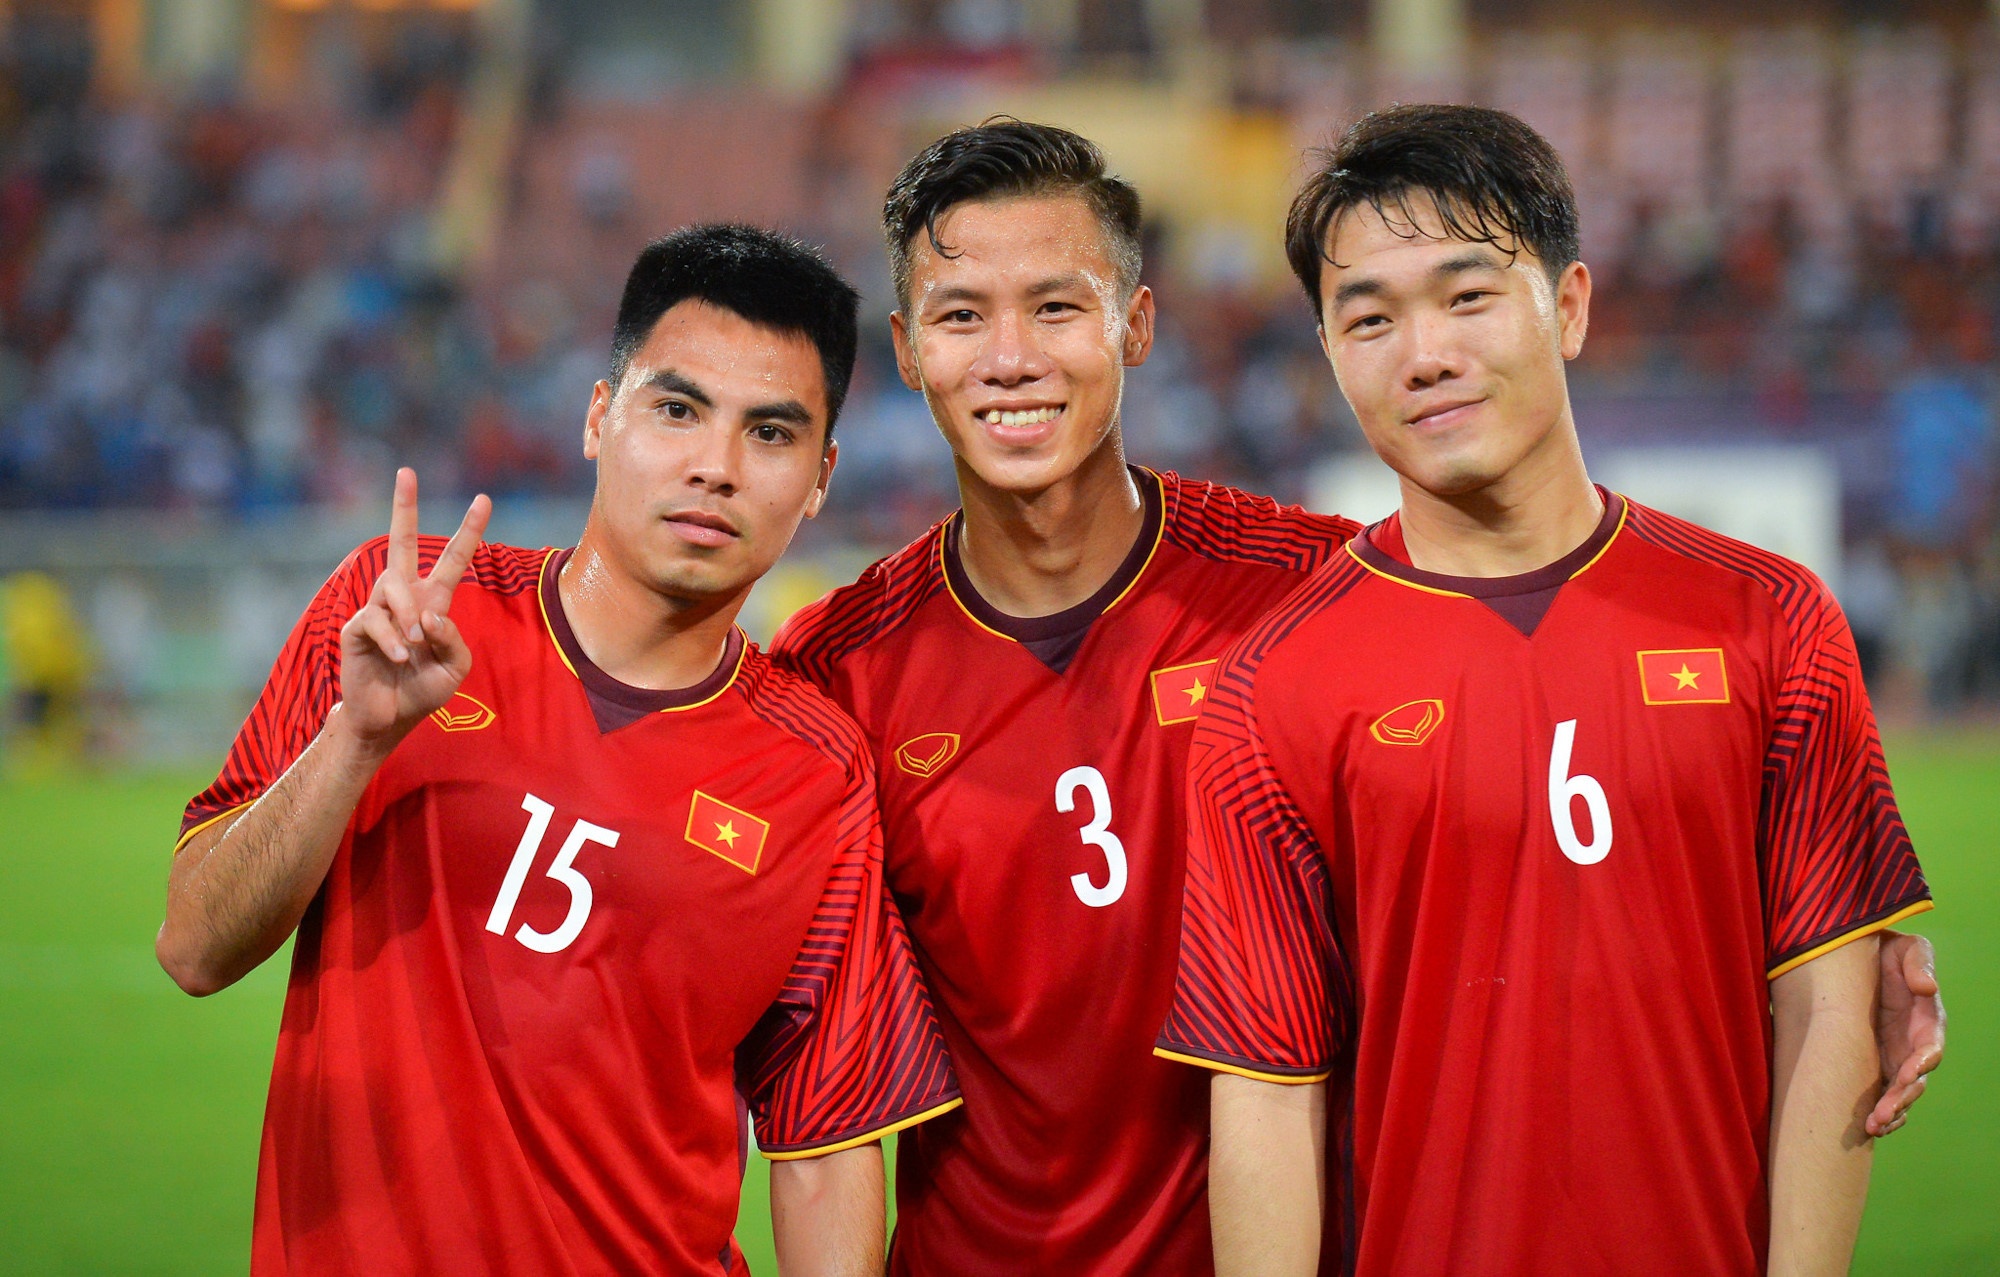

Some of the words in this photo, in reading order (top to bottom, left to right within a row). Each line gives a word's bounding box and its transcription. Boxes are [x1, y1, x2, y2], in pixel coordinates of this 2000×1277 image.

[1054, 765, 1128, 908] 3
[1548, 718, 1613, 866] 6
[484, 792, 621, 954] 15
